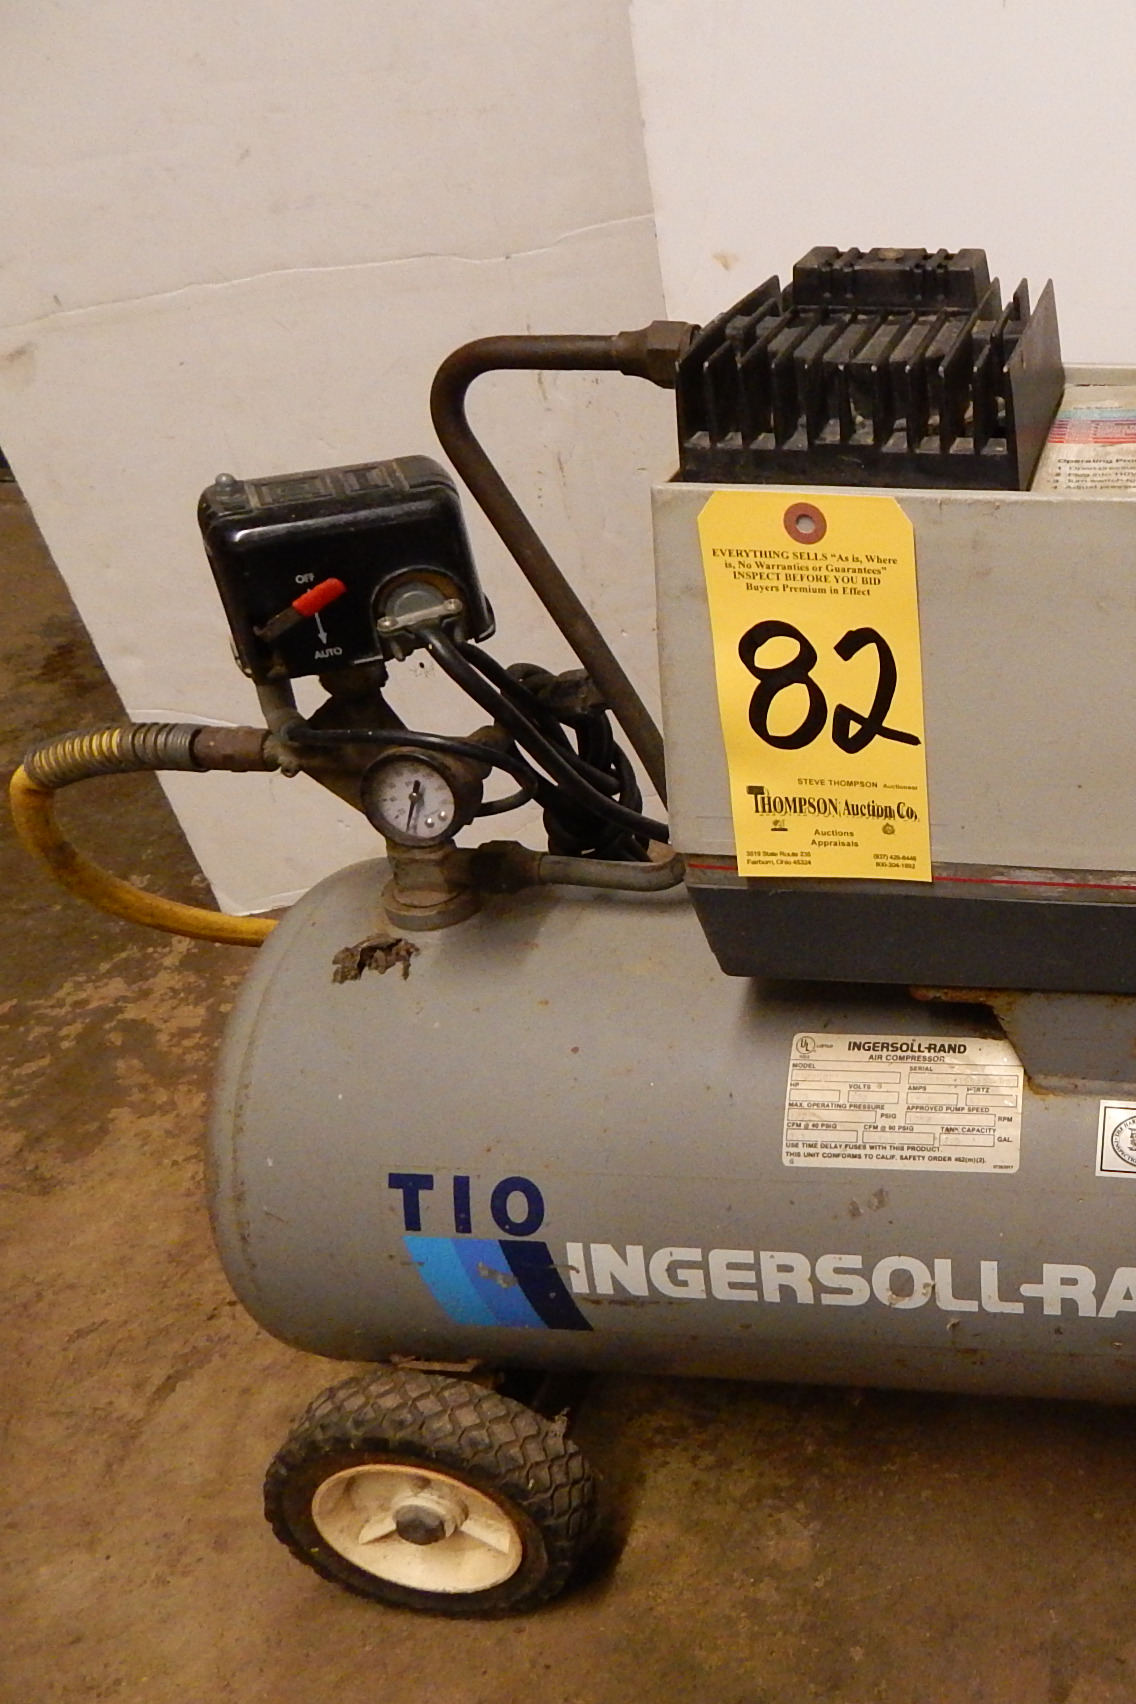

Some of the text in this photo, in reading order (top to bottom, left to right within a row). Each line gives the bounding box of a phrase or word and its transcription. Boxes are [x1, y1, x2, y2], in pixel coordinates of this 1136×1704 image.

[712, 549, 789, 559] EVERYTHING
[793, 552, 828, 561] SELLS
[852, 554, 862, 564] is,
[865, 555, 898, 564] Where
[725, 561, 735, 570] is,
[738, 561, 752, 569] No
[755, 562, 810, 572] Warranties
[295, 573, 315, 584] OFF
[733, 571, 881, 586] INSPECT BEFORE YOU BID
[746, 583, 779, 593] Buyers
[783, 585, 826, 594] Premium
[842, 587, 870, 596] Effect
[315, 647, 342, 659] AUTO
[738, 620, 921, 754] 82
[798, 778, 825, 786] STEVE
[828, 779, 877, 788] THOMPSON
[746, 786, 839, 814] THOMPSON
[843, 799, 894, 818] Auction
[811, 839, 859, 847] Appraisals
[847, 1040, 967, 1054] INGERSOLL-RAND
[885, 1055, 945, 1063] COMPRESSOR
